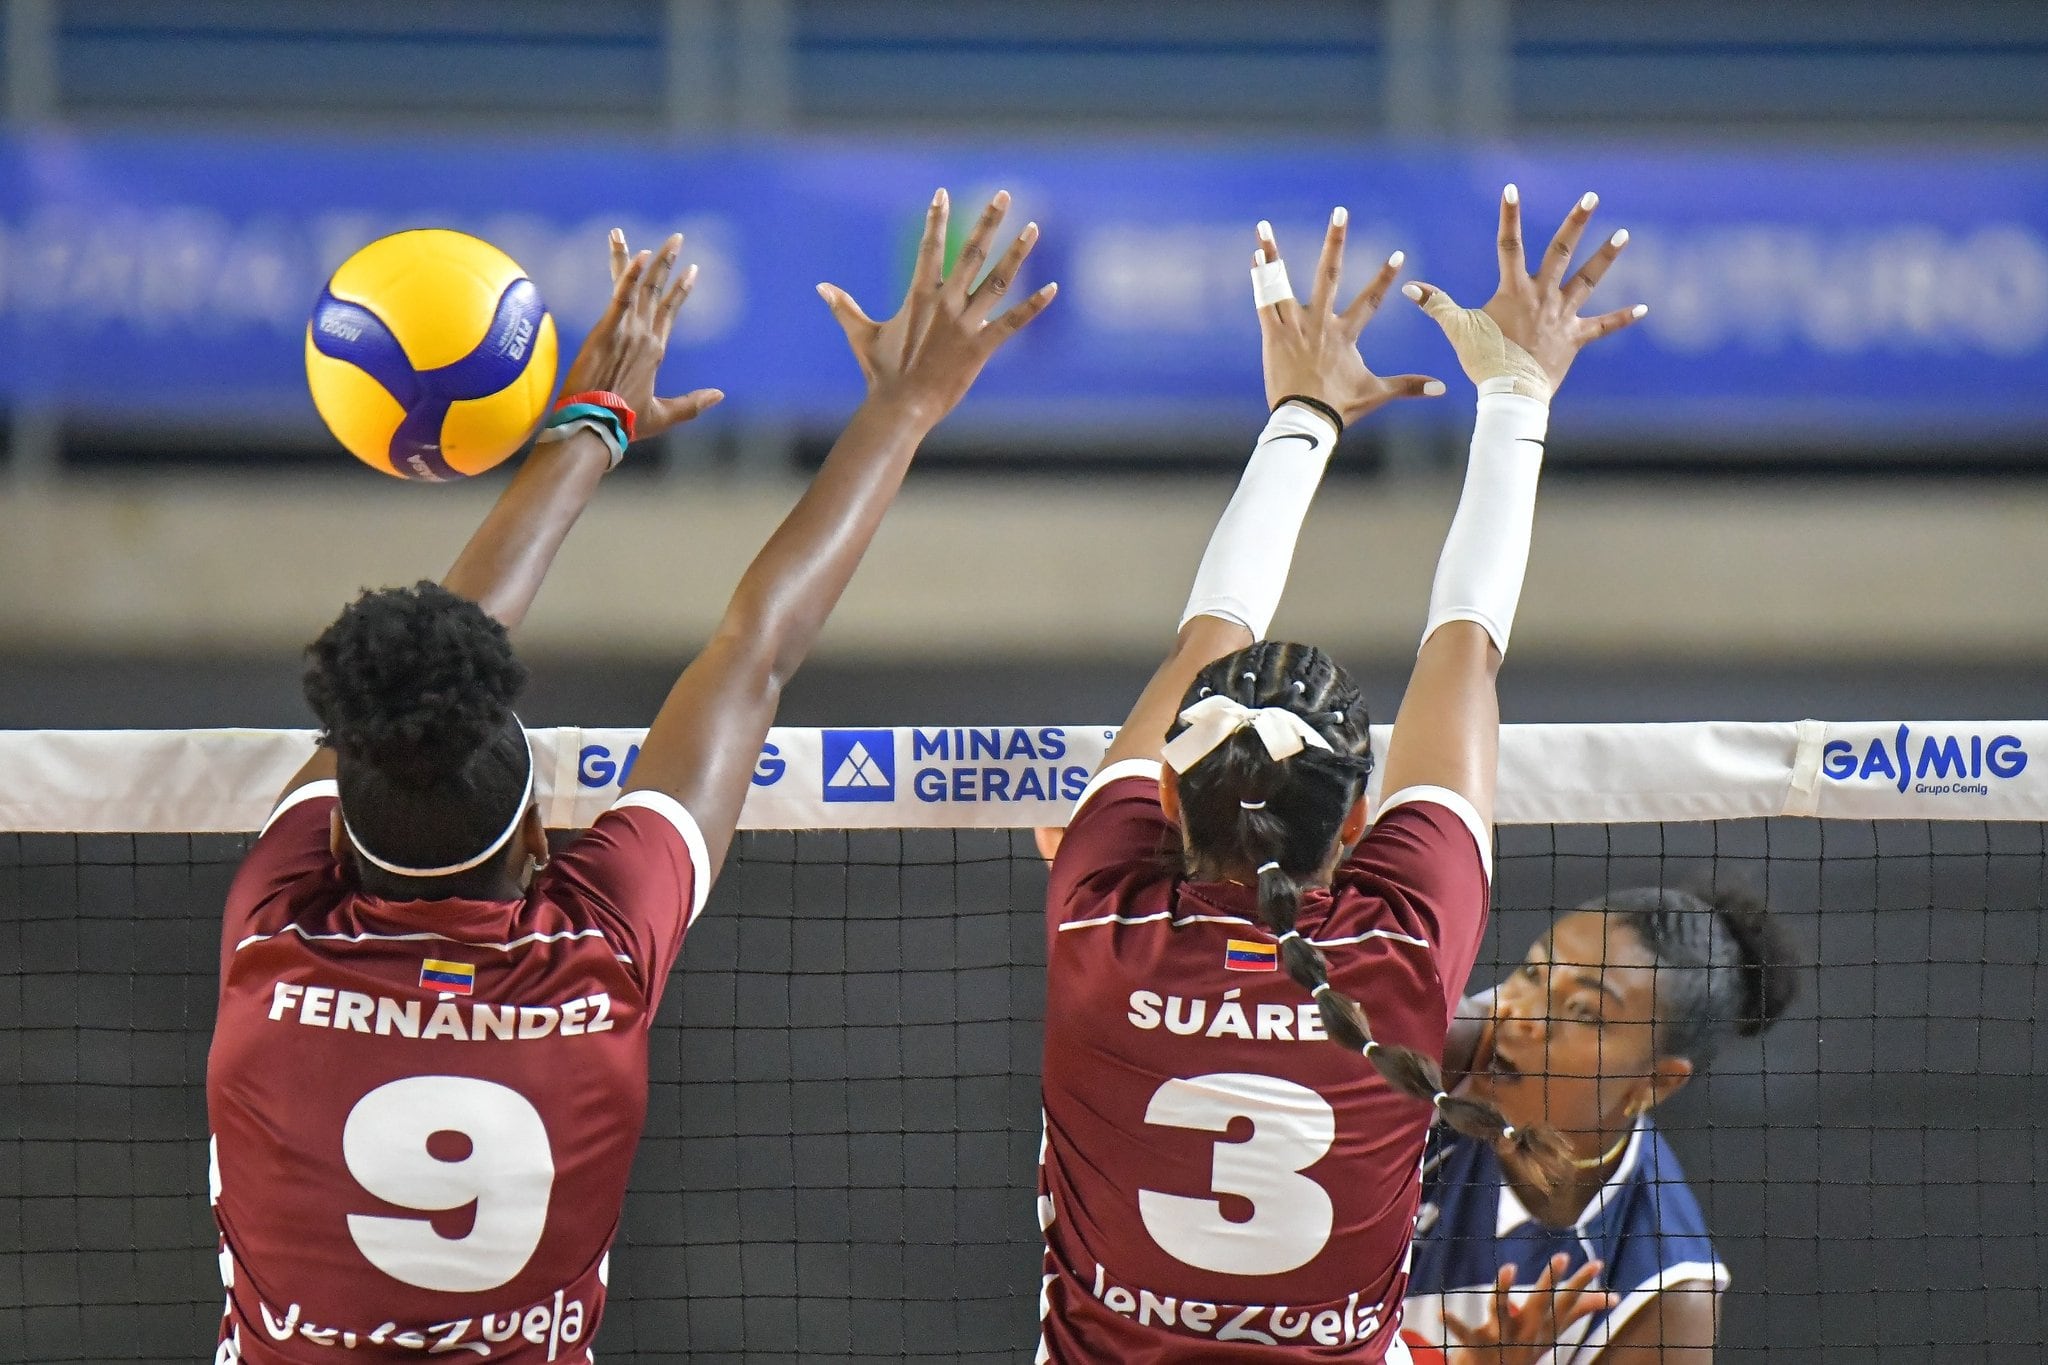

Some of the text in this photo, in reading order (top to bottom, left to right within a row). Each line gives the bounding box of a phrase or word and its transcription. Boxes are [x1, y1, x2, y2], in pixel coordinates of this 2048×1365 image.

[913, 727, 1067, 761] MINAS
[1822, 722, 2029, 794] GASMIG
[913, 766, 1090, 803] GERAIS
[1915, 782, 1988, 796] Grupo Cemig
[267, 982, 615, 1042] FERNÁNDEZ
[1127, 988, 1361, 1042] SUÁRE
[342, 1074, 556, 1293] 9
[1138, 1072, 1336, 1276] 3
